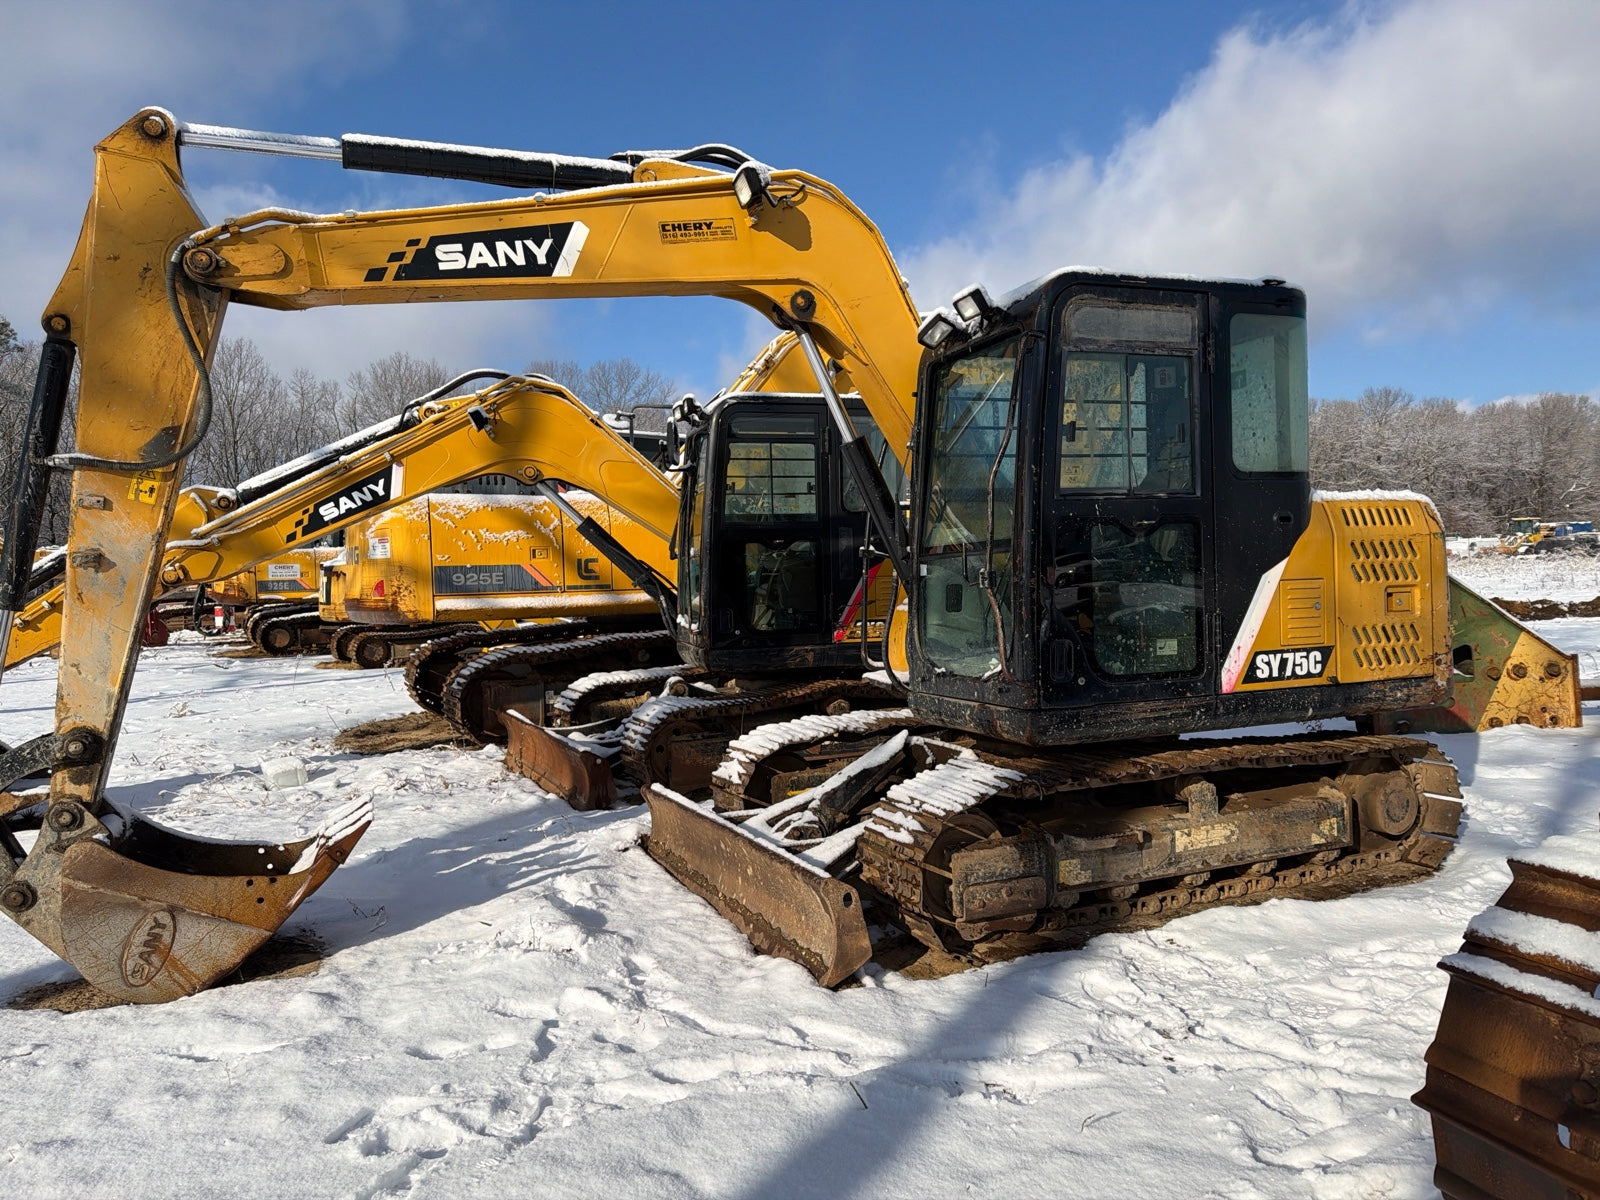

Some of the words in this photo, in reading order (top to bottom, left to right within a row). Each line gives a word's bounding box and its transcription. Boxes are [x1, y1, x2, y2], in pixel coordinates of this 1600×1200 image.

[661, 222, 714, 232] CHERY
[435, 238, 553, 271] SANY
[319, 478, 386, 522] SANY
[268, 582, 290, 590] 925E
[452, 573, 504, 586] 925E
[1256, 651, 1322, 678] SY75C
[131, 916, 167, 980] SANY
